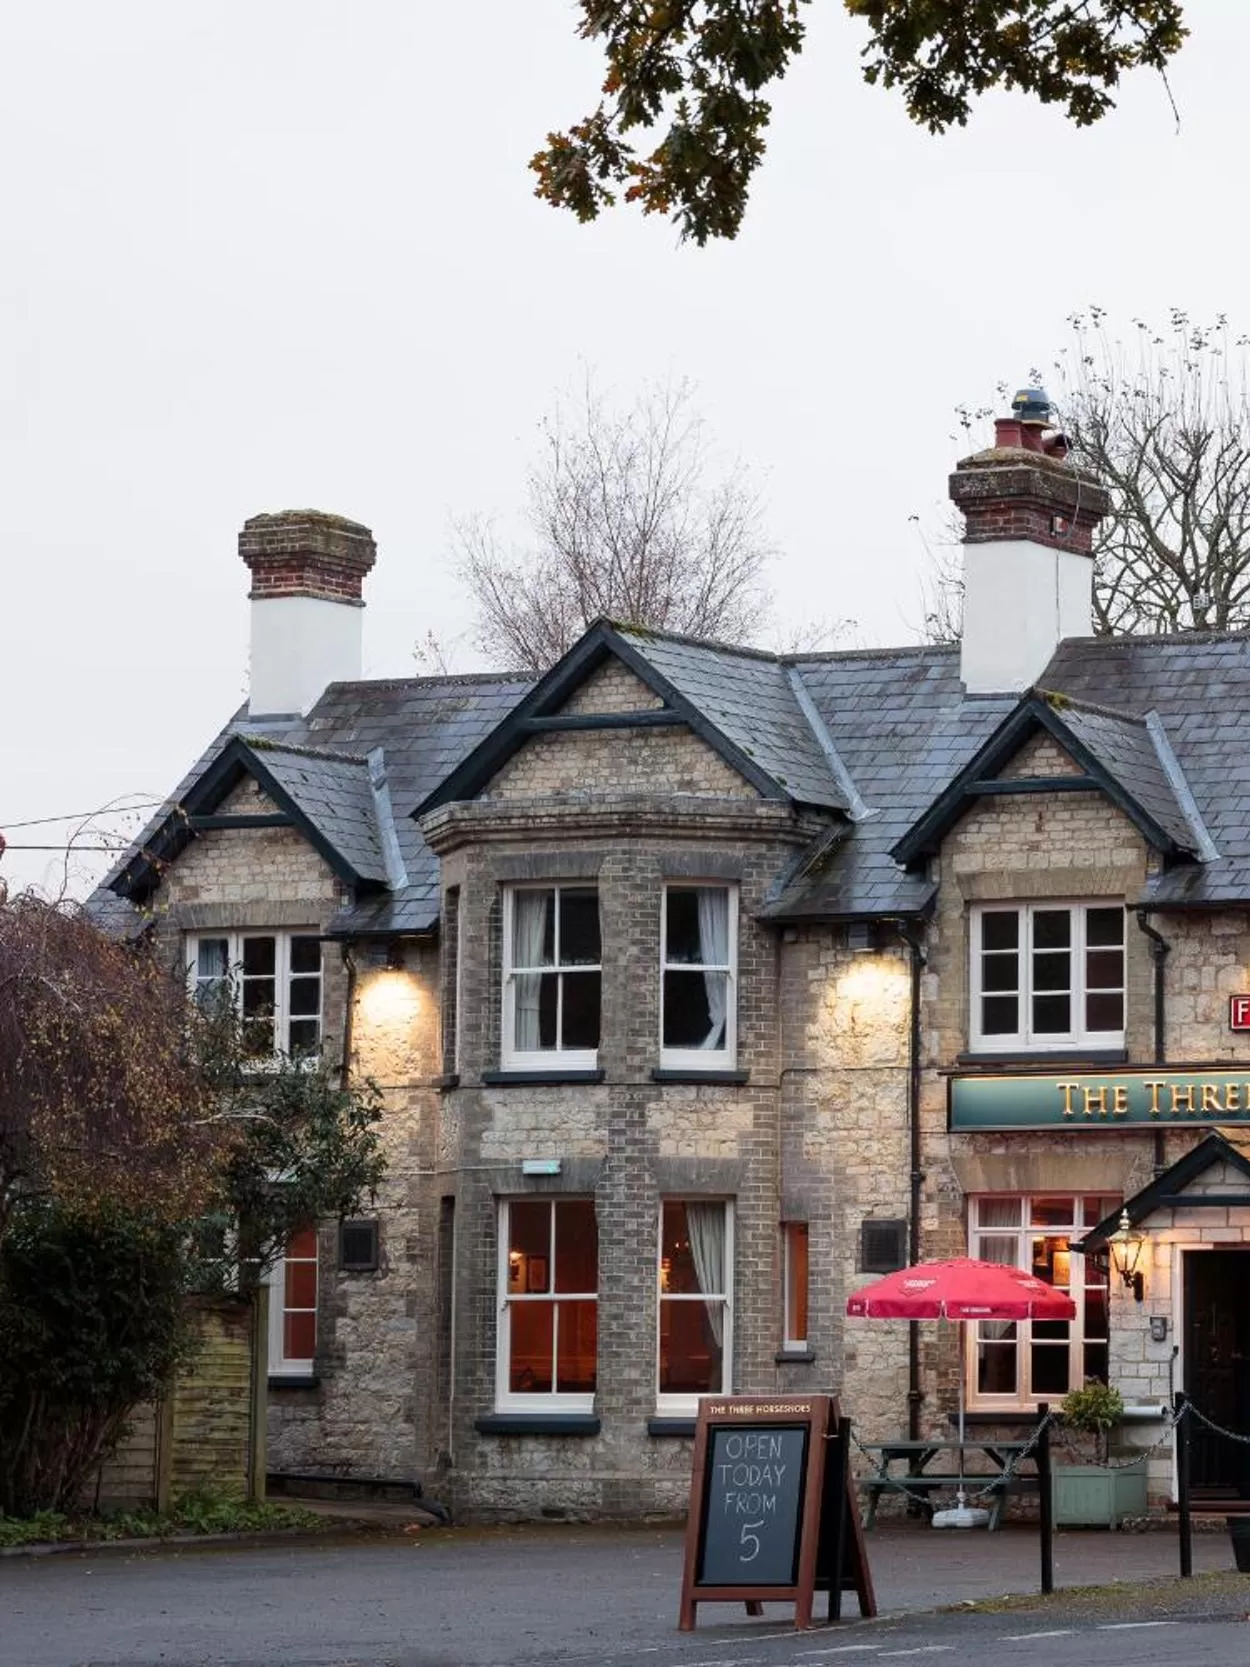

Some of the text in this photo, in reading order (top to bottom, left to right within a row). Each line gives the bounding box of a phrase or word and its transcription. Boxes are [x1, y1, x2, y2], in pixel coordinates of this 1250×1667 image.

[1056, 1081, 1129, 1115] THE
[710, 1404, 811, 1415] THE THREE HORSESHOES
[725, 1434, 783, 1460] OPEN
[718, 1463, 786, 1487] TODAY
[724, 1492, 776, 1516] FROM
[739, 1520, 764, 1562] 5
